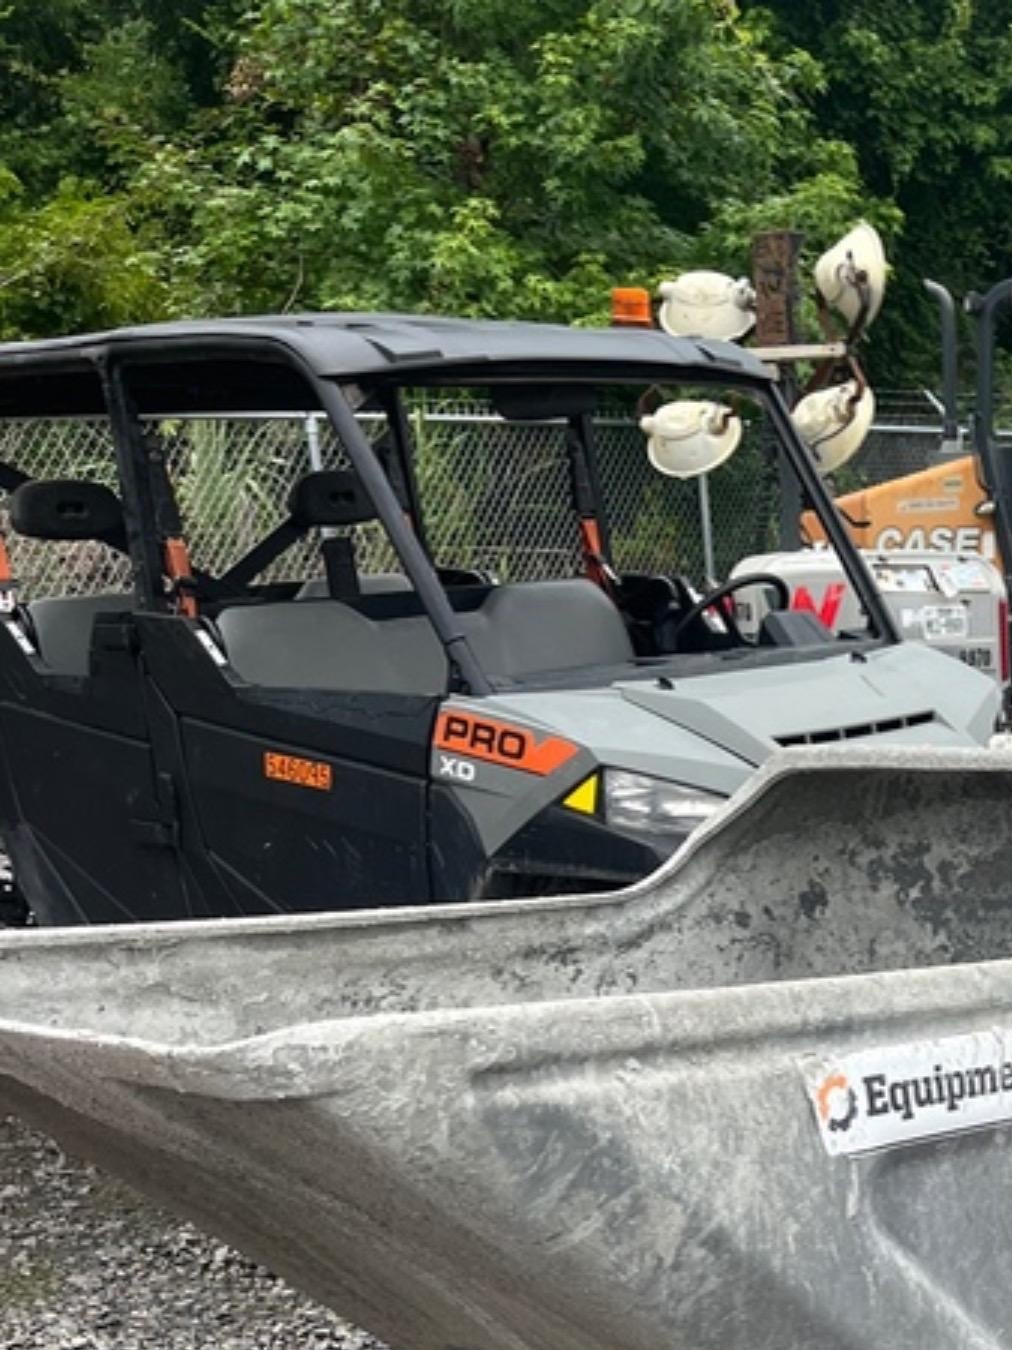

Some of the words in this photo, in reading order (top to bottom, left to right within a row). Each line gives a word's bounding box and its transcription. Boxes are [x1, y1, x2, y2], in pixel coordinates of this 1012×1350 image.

[877, 527, 980, 553] CASE
[443, 715, 526, 759] PRO
[439, 757, 475, 781] XD
